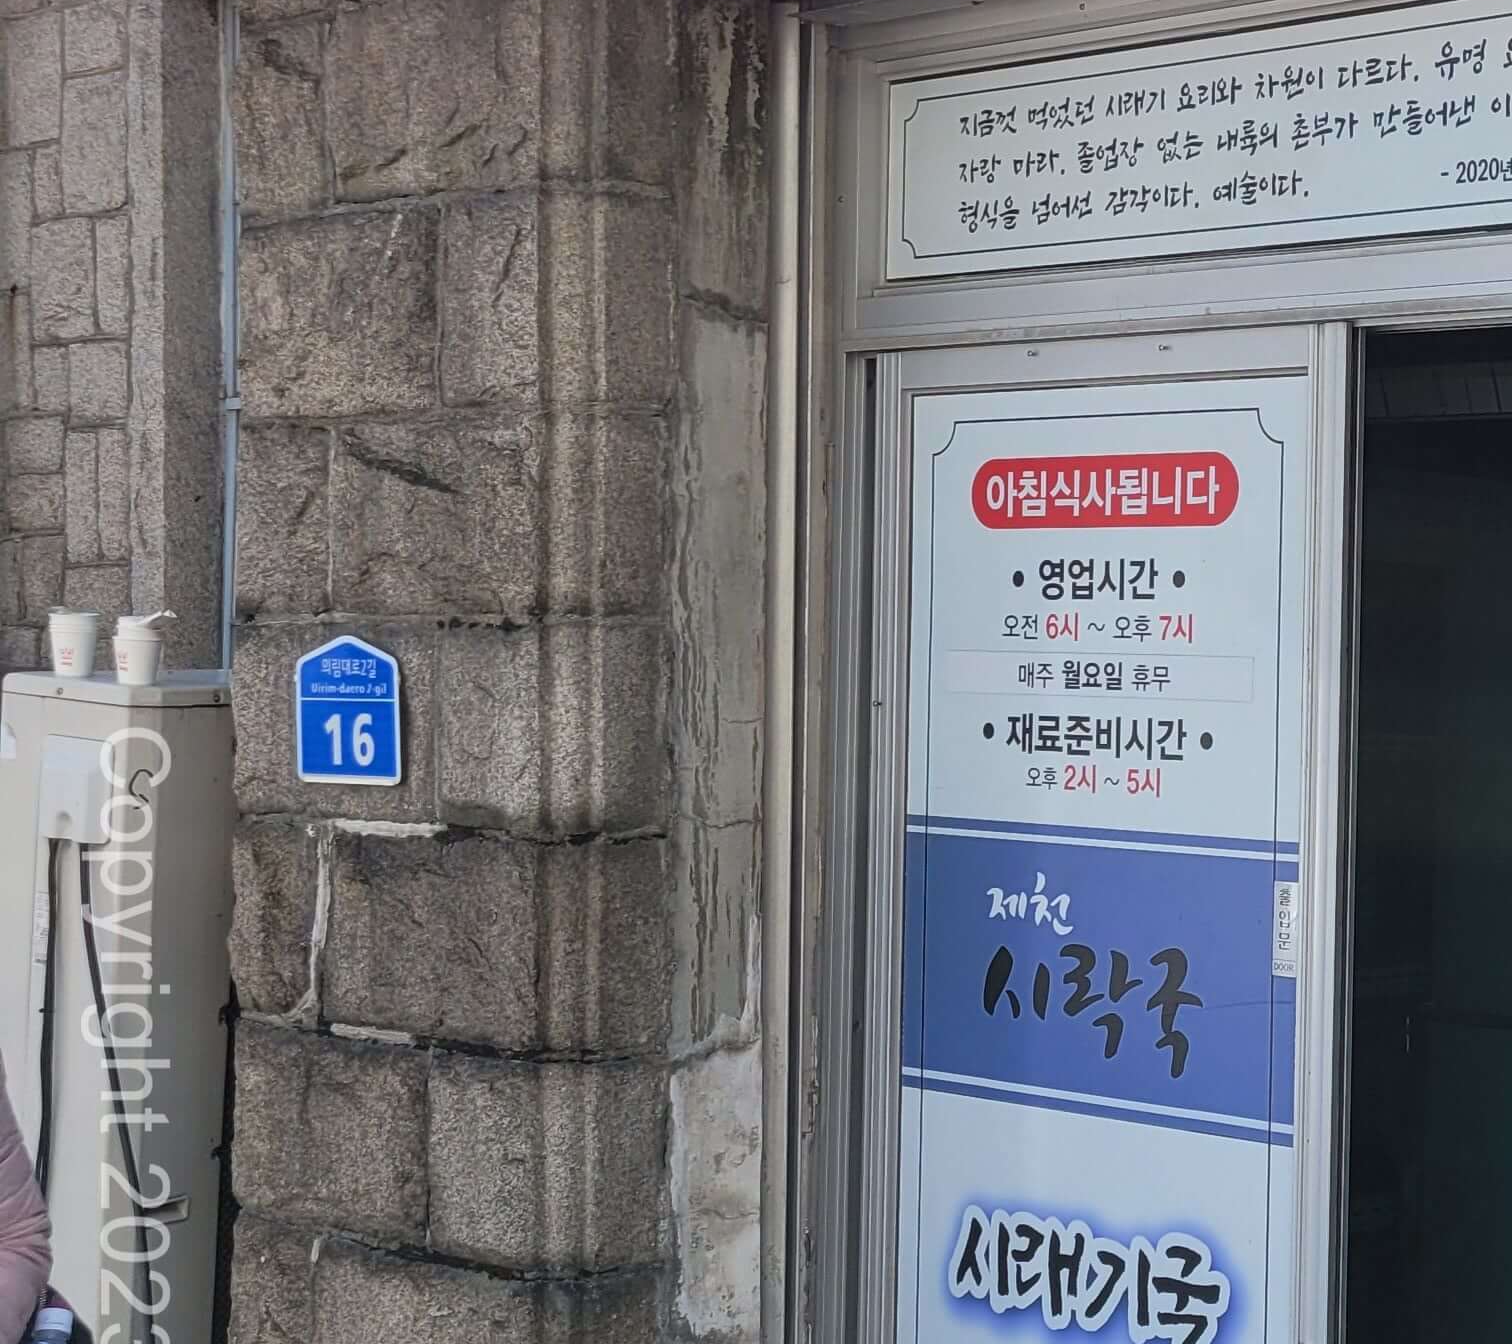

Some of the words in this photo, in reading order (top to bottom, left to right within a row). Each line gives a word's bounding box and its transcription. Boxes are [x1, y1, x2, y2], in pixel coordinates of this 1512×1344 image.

[959, 105, 1016, 137] 지금껏
[1028, 95, 1094, 130] 먹었던
[1106, 89, 1165, 118] 시래기
[1177, 77, 1242, 112] 요리와
[1255, 65, 1323, 101] 차원이
[1338, 54, 1418, 88] 다르다.
[1435, 39, 1487, 80] 유명
[959, 154, 1001, 185] 자랑
[1013, 150, 1066, 178] 마라.
[1077, 137, 1144, 174] 졸업장
[1157, 131, 1204, 163] 없는
[1217, 119, 1278, 156] 내륙의
[1291, 112, 1358, 151] 촌부가
[1374, 95, 1476, 138] 만들어낸
[1491, 94, 1511, 117] 이
[959, 196, 1020, 233] 형식을
[1032, 191, 1093, 225] 넘어선
[1105, 182, 1200, 216] 감각이다.
[1213, 170, 1309, 205] 예술이다.
[986, 464, 1220, 517] 아침식사됩니다
[1038, 558, 1159, 601] 영업시간
[1002, 613, 1039, 640] 오전
[1046, 612, 1080, 643] 6시
[1113, 615, 1152, 642] 오후
[1159, 614, 1194, 644] 7시
[1018, 662, 1054, 688] 매주
[1062, 660, 1123, 691] 월요일
[1132, 665, 1171, 692] 휴무
[324, 713, 375, 766] 16
[1006, 712, 1187, 761] 재료준비시간
[1026, 767, 1058, 791] 오후
[1064, 764, 1097, 794] 2시
[1127, 768, 1162, 798] 5시
[986, 871, 1075, 936] 제천
[1279, 888, 1291, 951] 출입문
[983, 943, 1204, 1078] 시락국
